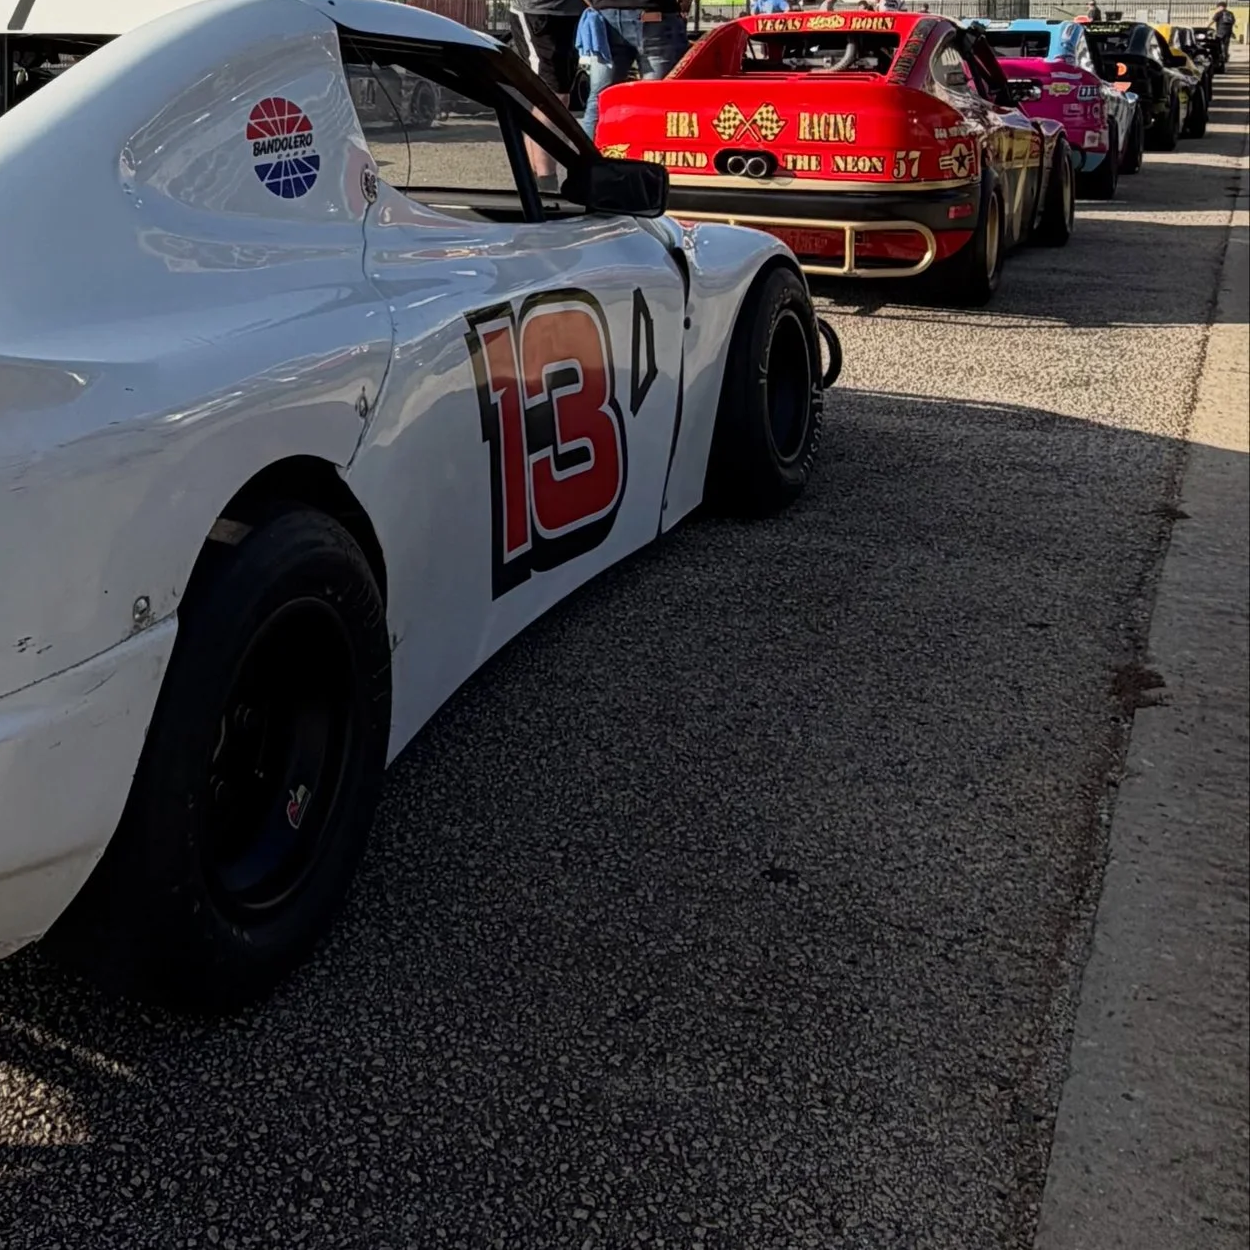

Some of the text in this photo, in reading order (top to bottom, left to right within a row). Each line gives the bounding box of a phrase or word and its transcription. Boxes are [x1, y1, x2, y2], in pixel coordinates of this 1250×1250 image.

[757, 17, 801, 31] VEGAS
[850, 16, 894, 31] BORN
[666, 111, 856, 143] HBA RACING
[252, 133, 313, 157] BANDOLERO
[643, 150, 884, 173] BEHIND THE NEON
[893, 151, 921, 179] 57
[464, 288, 628, 600] 13
